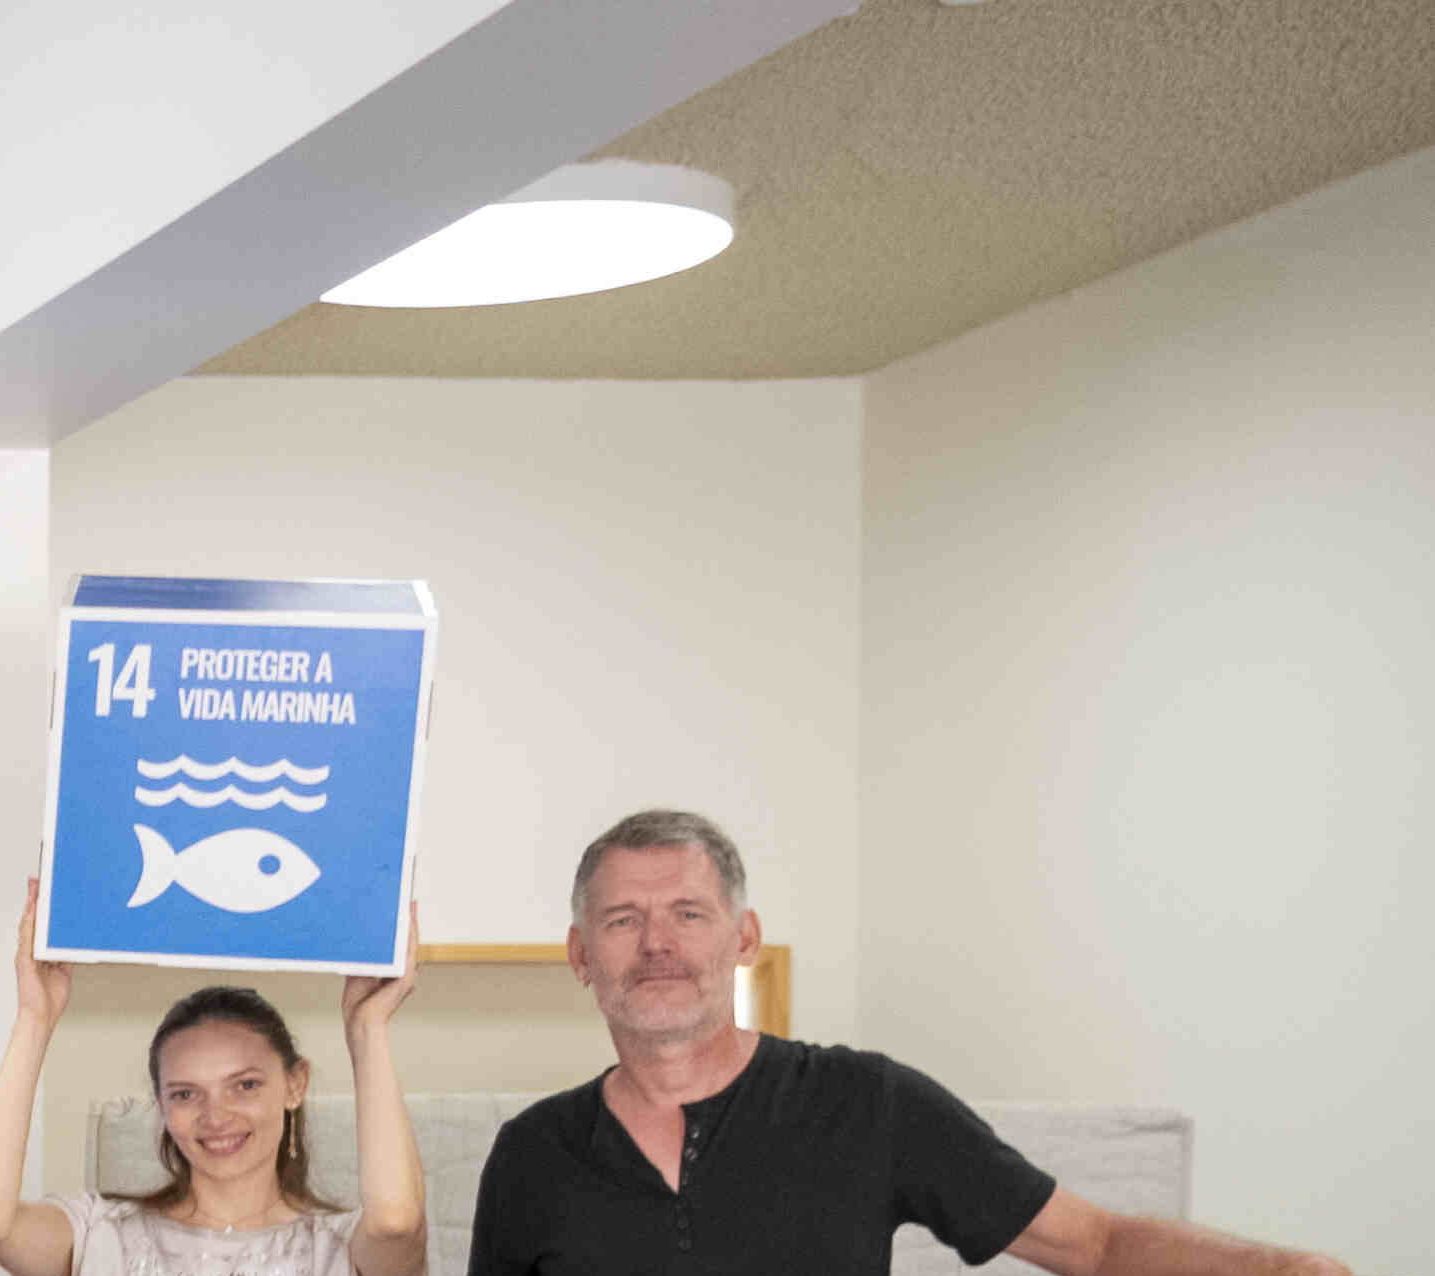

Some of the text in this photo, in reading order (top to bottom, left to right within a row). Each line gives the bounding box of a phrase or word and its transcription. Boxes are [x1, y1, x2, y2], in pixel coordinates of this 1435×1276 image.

[88, 642, 157, 718] 14
[180, 647, 333, 684] PROTEGER A
[179, 687, 357, 725] VIDA MARINHA
